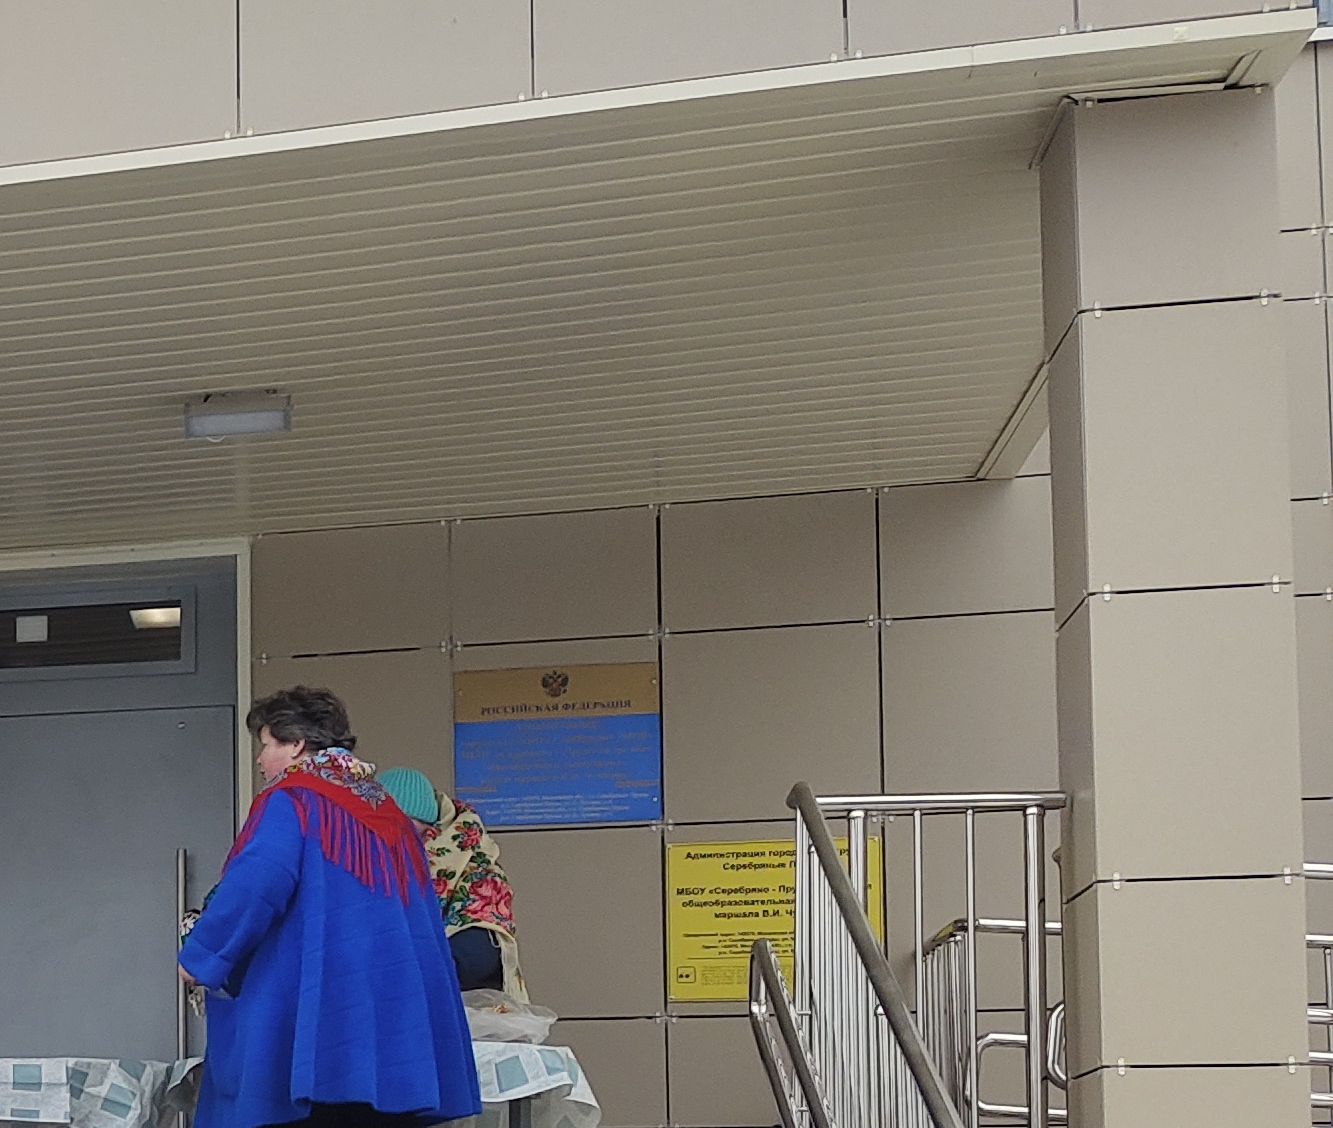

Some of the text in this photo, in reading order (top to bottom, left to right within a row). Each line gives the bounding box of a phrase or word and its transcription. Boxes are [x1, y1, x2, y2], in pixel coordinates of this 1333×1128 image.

[685, 850, 766, 861] Администрация
[723, 862, 787, 871] Серебряные
[676, 887, 706, 896] МБОУ
[714, 911, 760, 920] маршала
